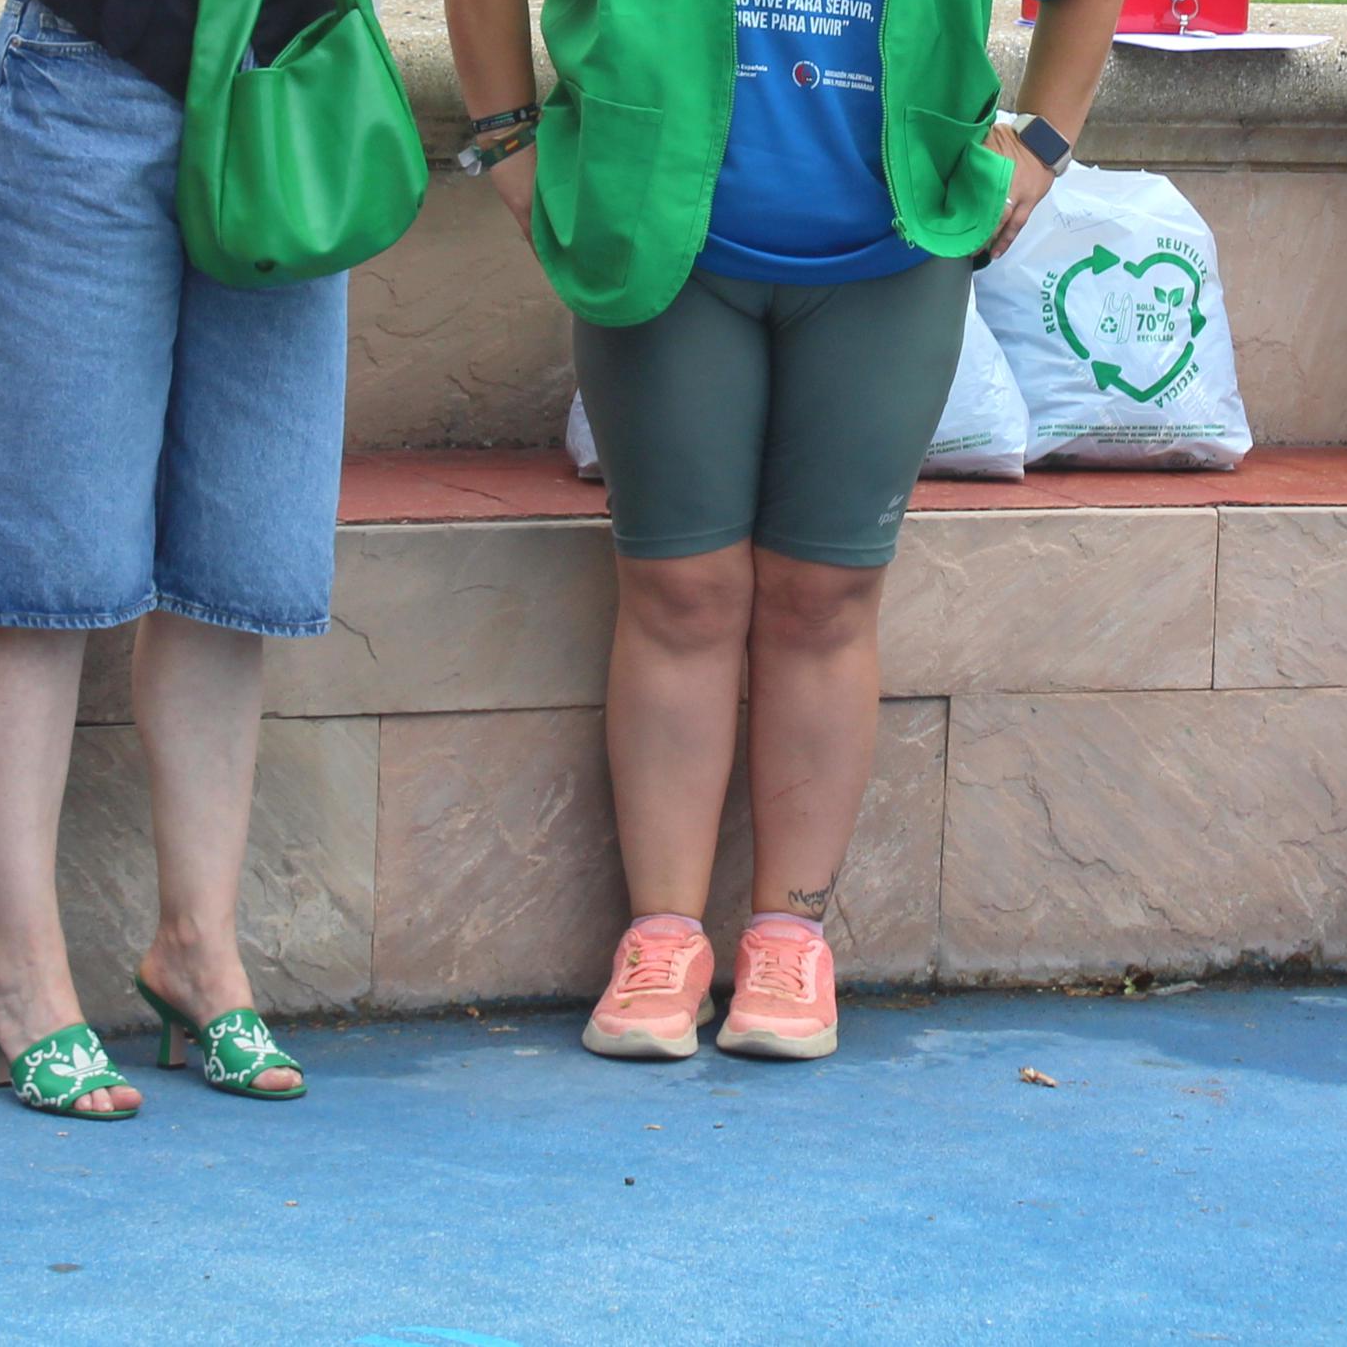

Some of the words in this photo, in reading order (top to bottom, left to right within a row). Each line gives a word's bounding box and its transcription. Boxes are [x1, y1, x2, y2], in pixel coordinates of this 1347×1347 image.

[735, 10, 768, 29] IRVE
[771, 12, 806, 33] PARA
[1040, 270, 1058, 334] REDUCE
[1135, 312, 1175, 332] 70%
[1154, 361, 1200, 408] RECICLA
